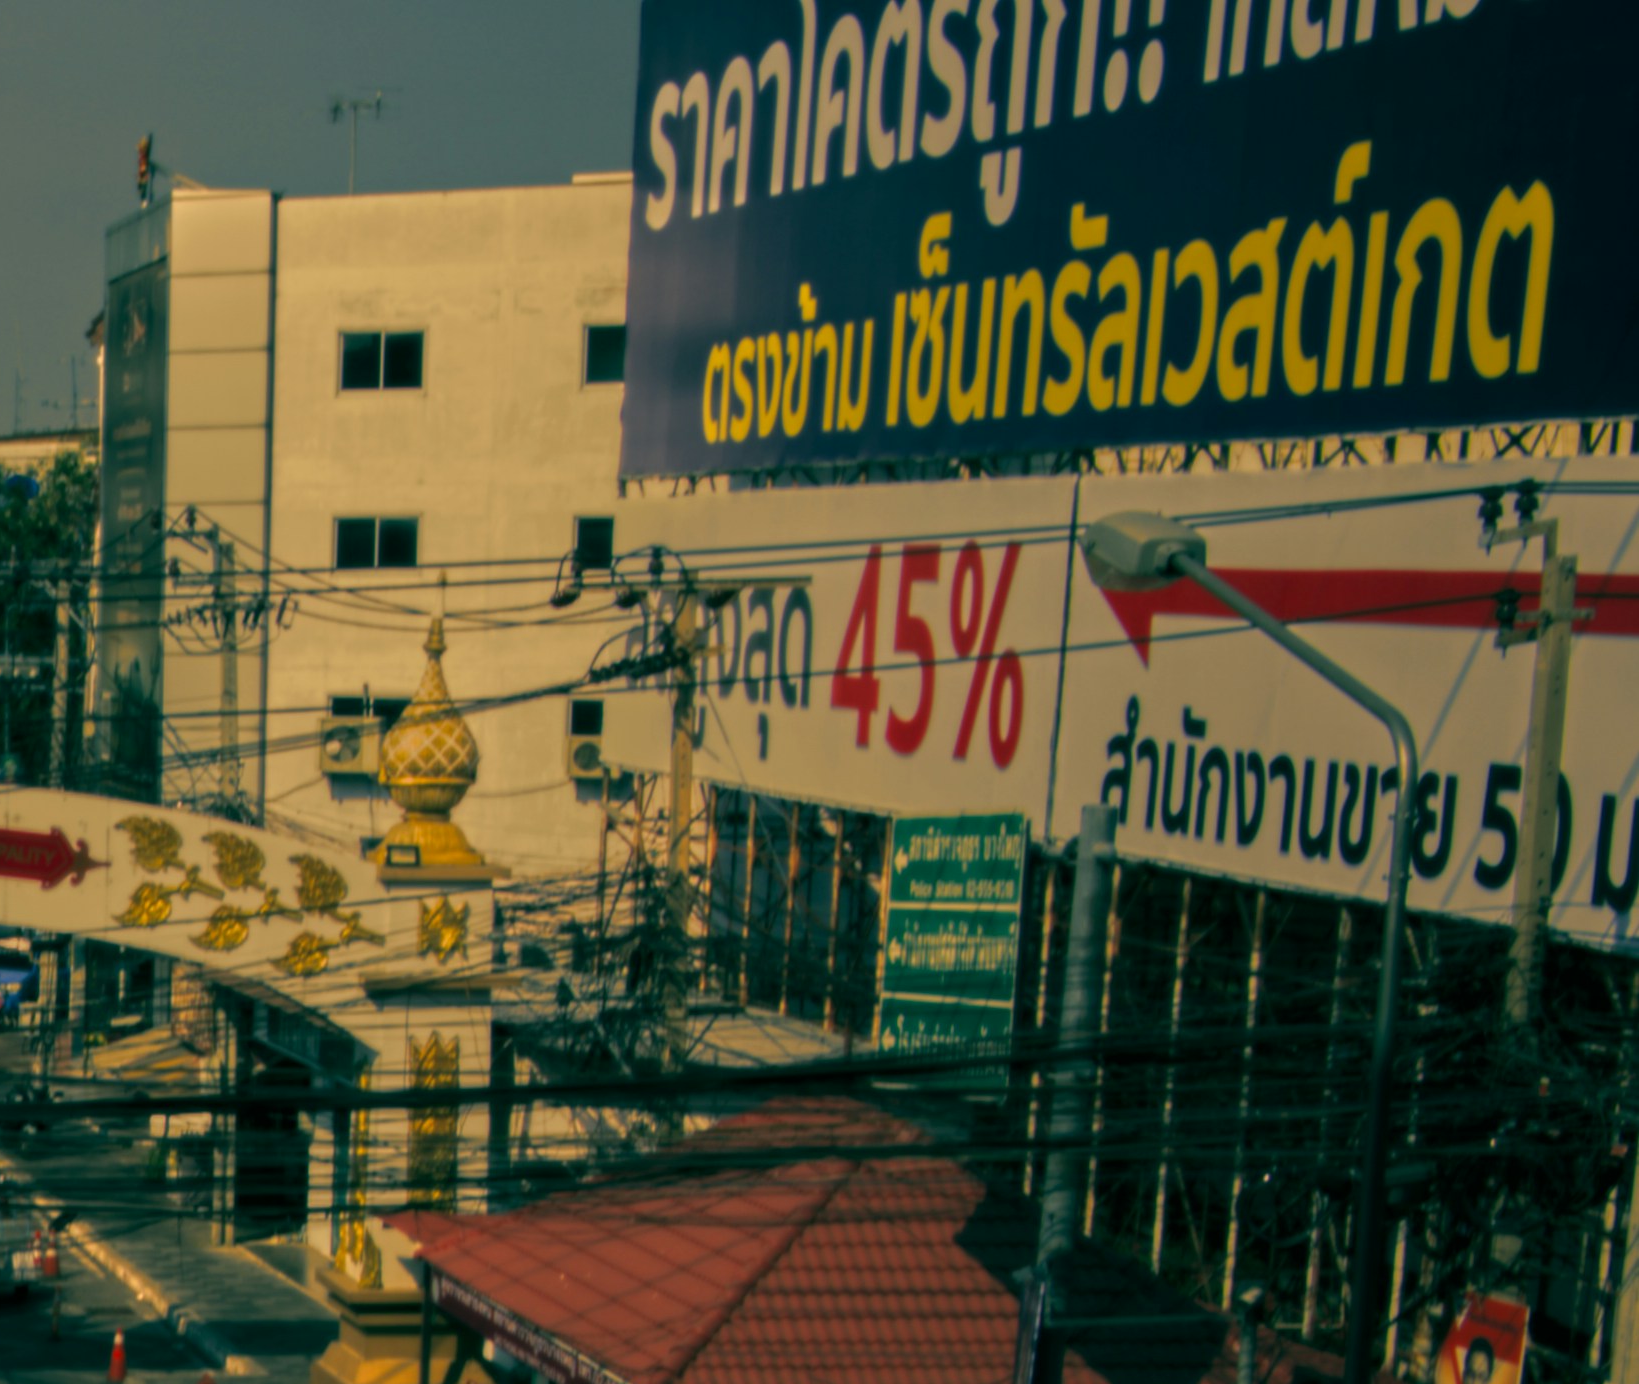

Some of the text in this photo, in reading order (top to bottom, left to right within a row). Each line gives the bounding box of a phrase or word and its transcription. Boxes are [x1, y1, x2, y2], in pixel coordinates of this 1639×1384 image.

[702, 139, 1557, 445] ตรงข้าม เซ็นทรัลเวสต์เกต
[830, 541, 1023, 770] 45%
